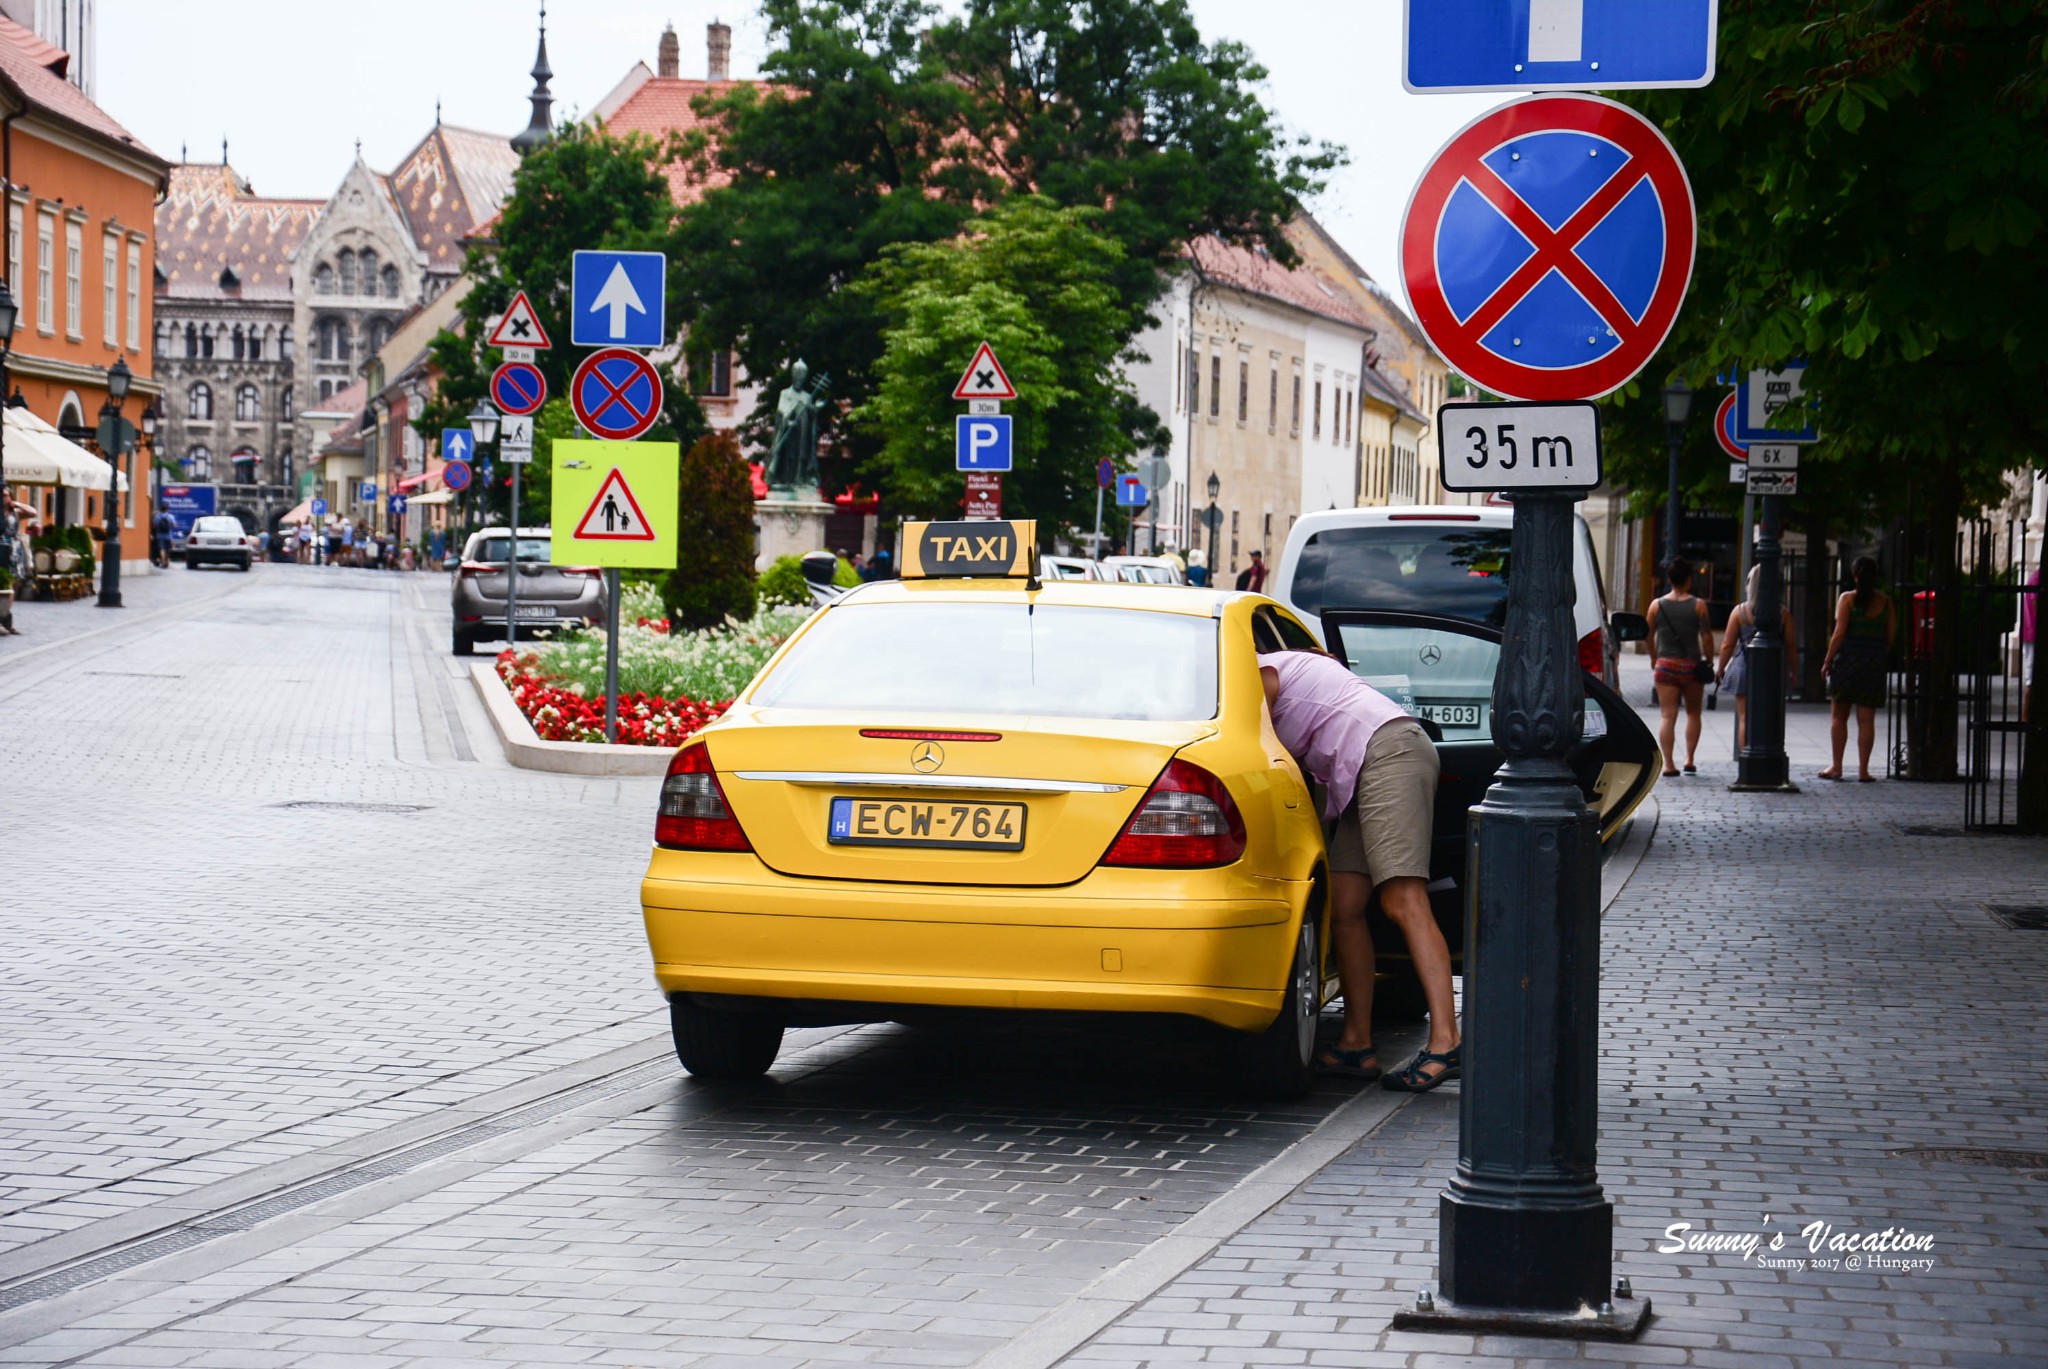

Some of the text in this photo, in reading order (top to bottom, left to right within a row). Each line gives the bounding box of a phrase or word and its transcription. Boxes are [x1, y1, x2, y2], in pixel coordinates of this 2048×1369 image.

[508, 350, 518, 359] 30
[1768, 382, 1790, 392] TAXI
[969, 423, 999, 464] P
[1465, 424, 1574, 470] 35 m
[1750, 484, 1793, 493] MOTOR STOP
[930, 536, 1008, 562] TAXI
[835, 821, 847, 833] H
[857, 803, 1013, 839] ECW-764
